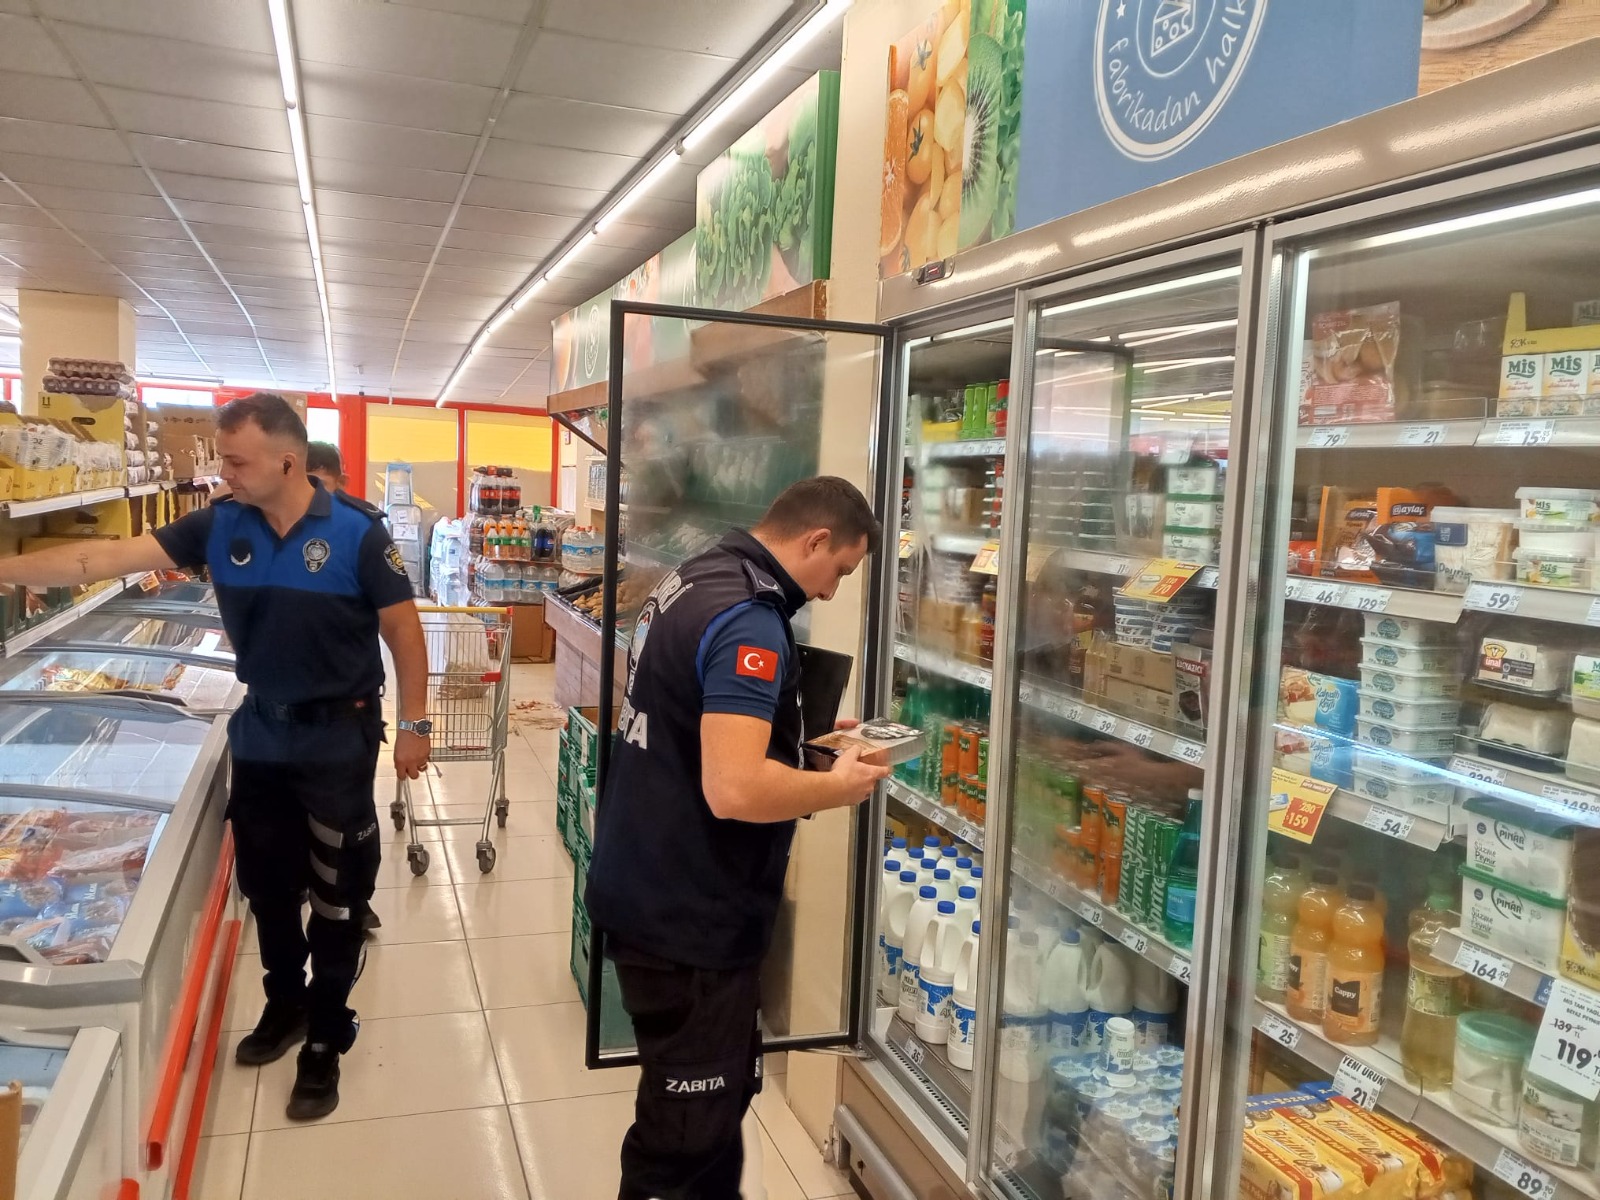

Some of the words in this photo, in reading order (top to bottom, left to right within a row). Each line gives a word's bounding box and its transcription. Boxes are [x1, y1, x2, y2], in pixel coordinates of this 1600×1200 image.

[1109, 37, 1201, 132] fabrikadan
[1323, 434, 1341, 447] 79
[1423, 430, 1440, 444] 21
[1521, 430, 1541, 446] 15
[1316, 590, 1334, 603] 46
[1357, 597, 1378, 611] 129
[1487, 592, 1510, 609] 59
[1066, 709, 1078, 720] 33
[1099, 720, 1111, 732] 39
[1133, 732, 1146, 745] 48
[1182, 746, 1197, 759] 235
[1289, 812, 1309, 829] 159
[1381, 818, 1402, 836] 54
[1092, 911, 1100, 922] 13
[1135, 939, 1144, 951] 13
[1472, 959, 1498, 981] 164
[1334, 986, 1357, 999] Cappy
[1279, 1029, 1295, 1045] 25
[1558, 1038, 1593, 1070] 119
[1342, 1055, 1362, 1072] YENI
[1361, 1065, 1386, 1086] URUN
[665, 1075, 726, 1093] ZABITA
[1351, 1086, 1368, 1107] 21
[1517, 1171, 1543, 1195] 89
